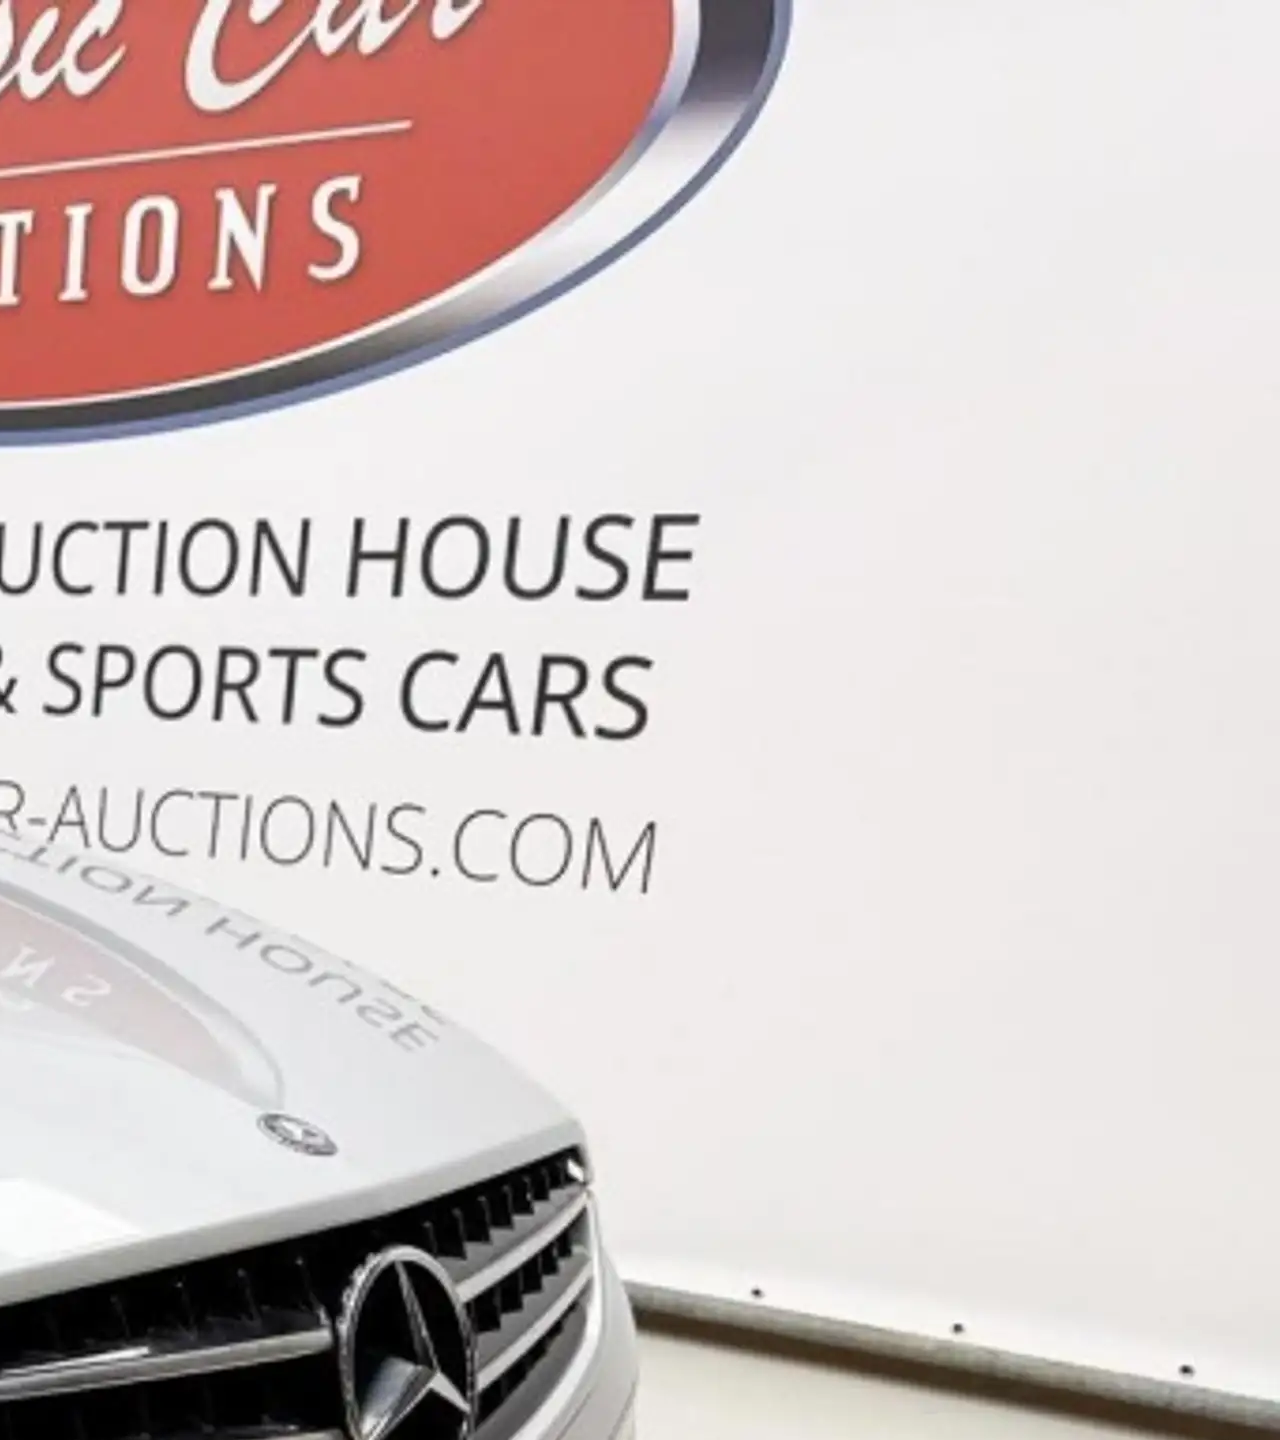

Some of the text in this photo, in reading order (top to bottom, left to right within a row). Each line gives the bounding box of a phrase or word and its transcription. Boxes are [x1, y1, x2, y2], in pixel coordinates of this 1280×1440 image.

[345, 513, 702, 601] HOUSE
[42, 641, 368, 729] SPORTS
[398, 648, 655, 741] CARS
